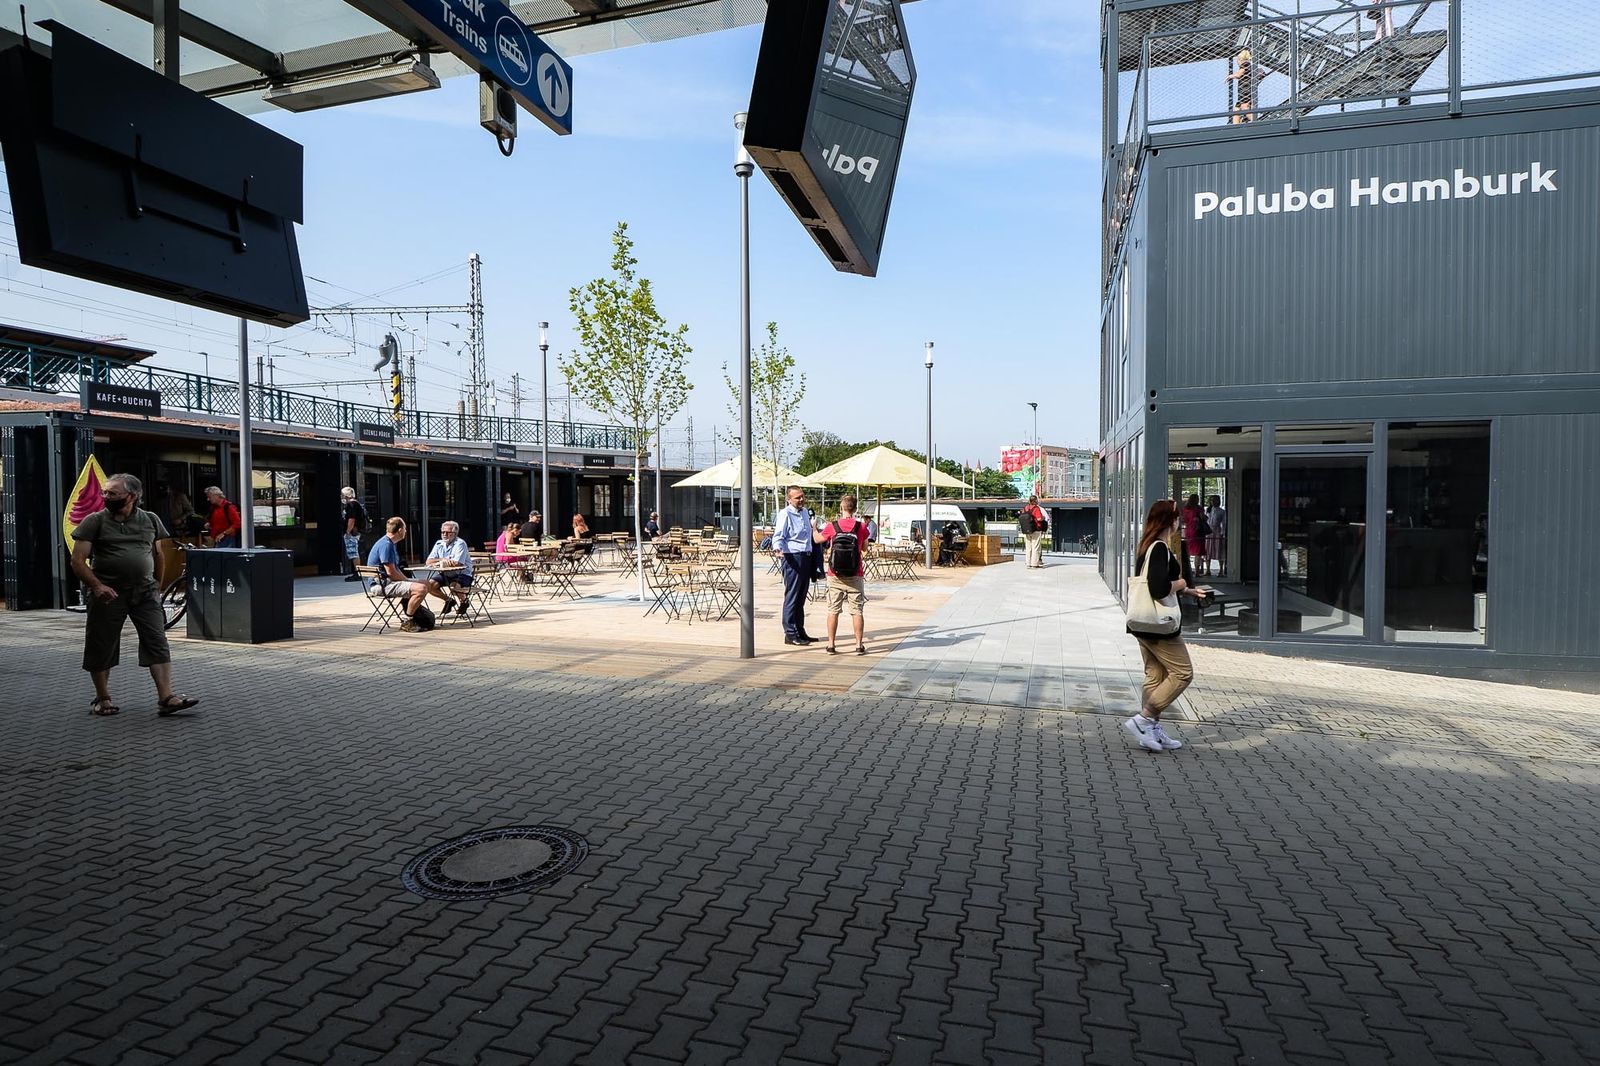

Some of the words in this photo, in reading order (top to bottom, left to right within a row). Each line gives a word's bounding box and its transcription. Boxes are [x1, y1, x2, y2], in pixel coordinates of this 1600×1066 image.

[440, 0, 488, 54] Trains
[1194, 183, 1335, 220] Paluba
[1350, 162, 1559, 207] Hamburk
[96, 392, 153, 408] KAFE+BUCHTA
